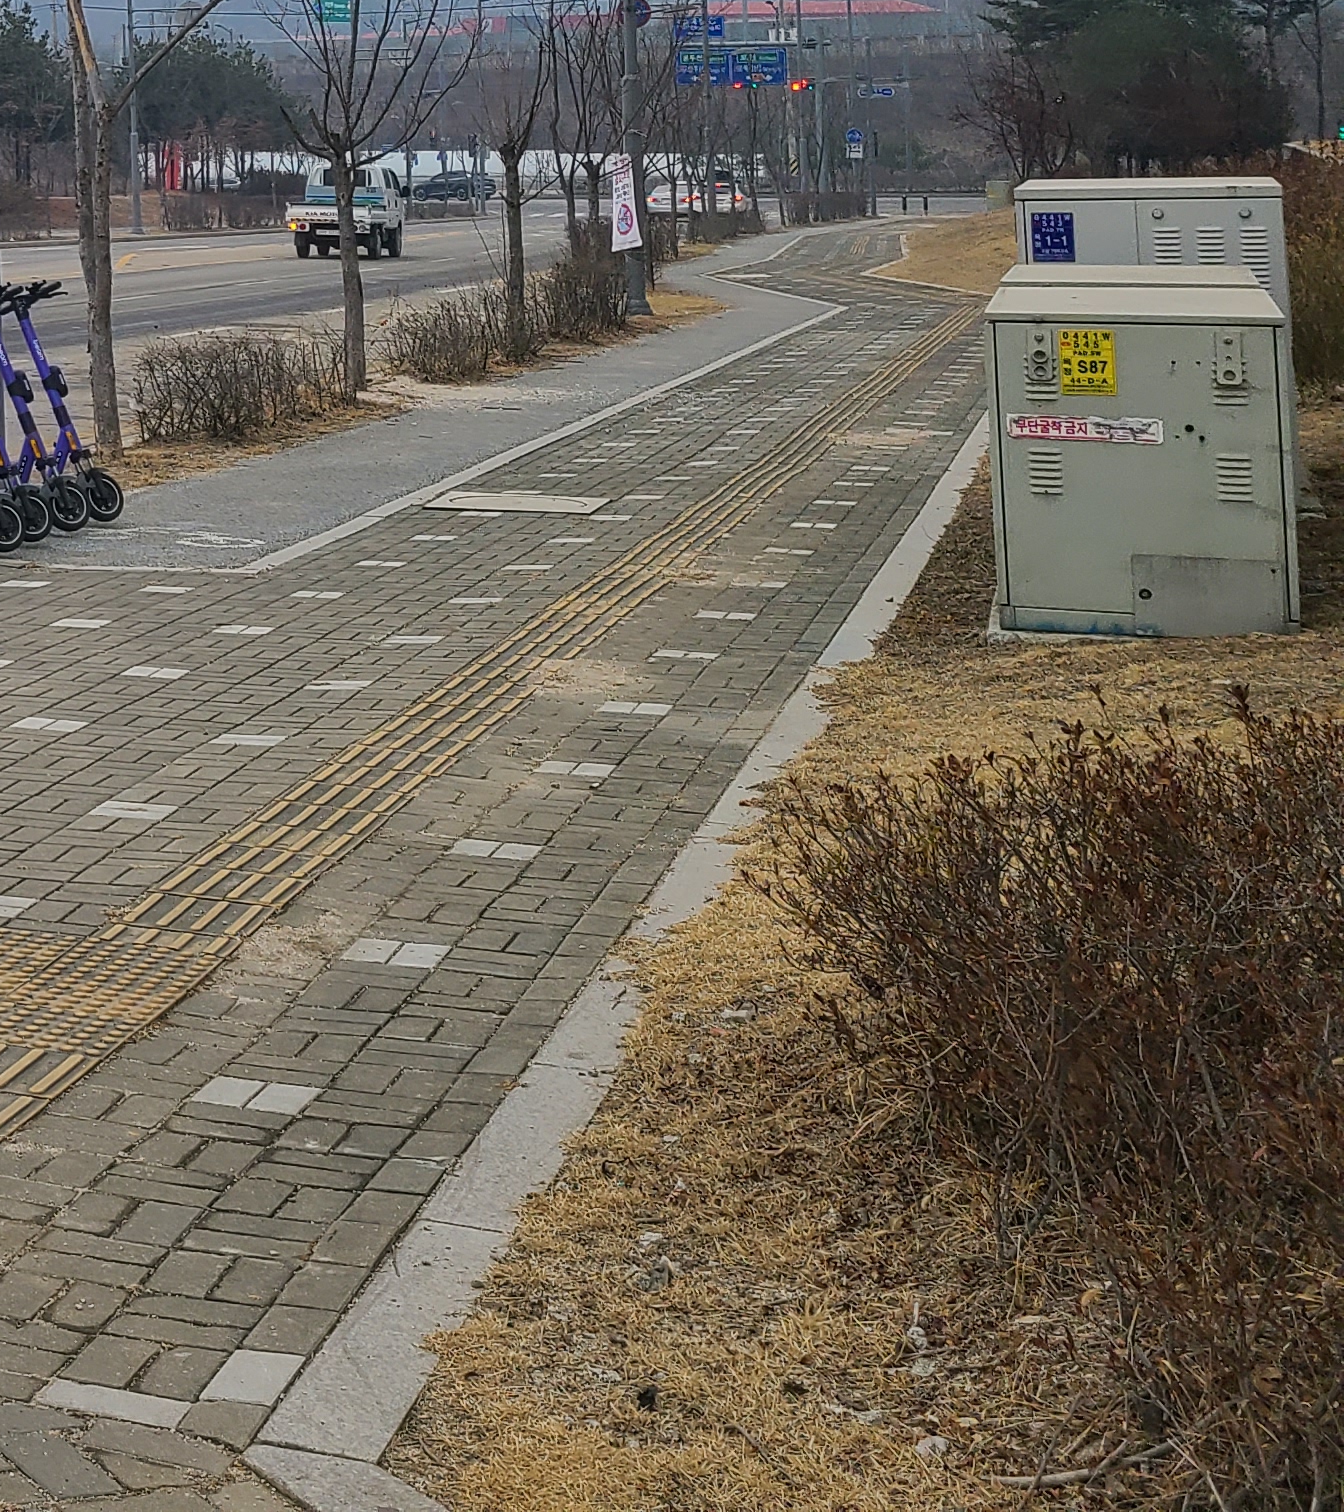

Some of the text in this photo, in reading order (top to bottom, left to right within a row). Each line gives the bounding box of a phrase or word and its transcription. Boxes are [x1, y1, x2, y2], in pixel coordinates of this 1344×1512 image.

[1044, 235, 1068, 247] 1-1
[1077, 359, 1108, 375] S87
[1070, 377, 1109, 385] 44-D-A
